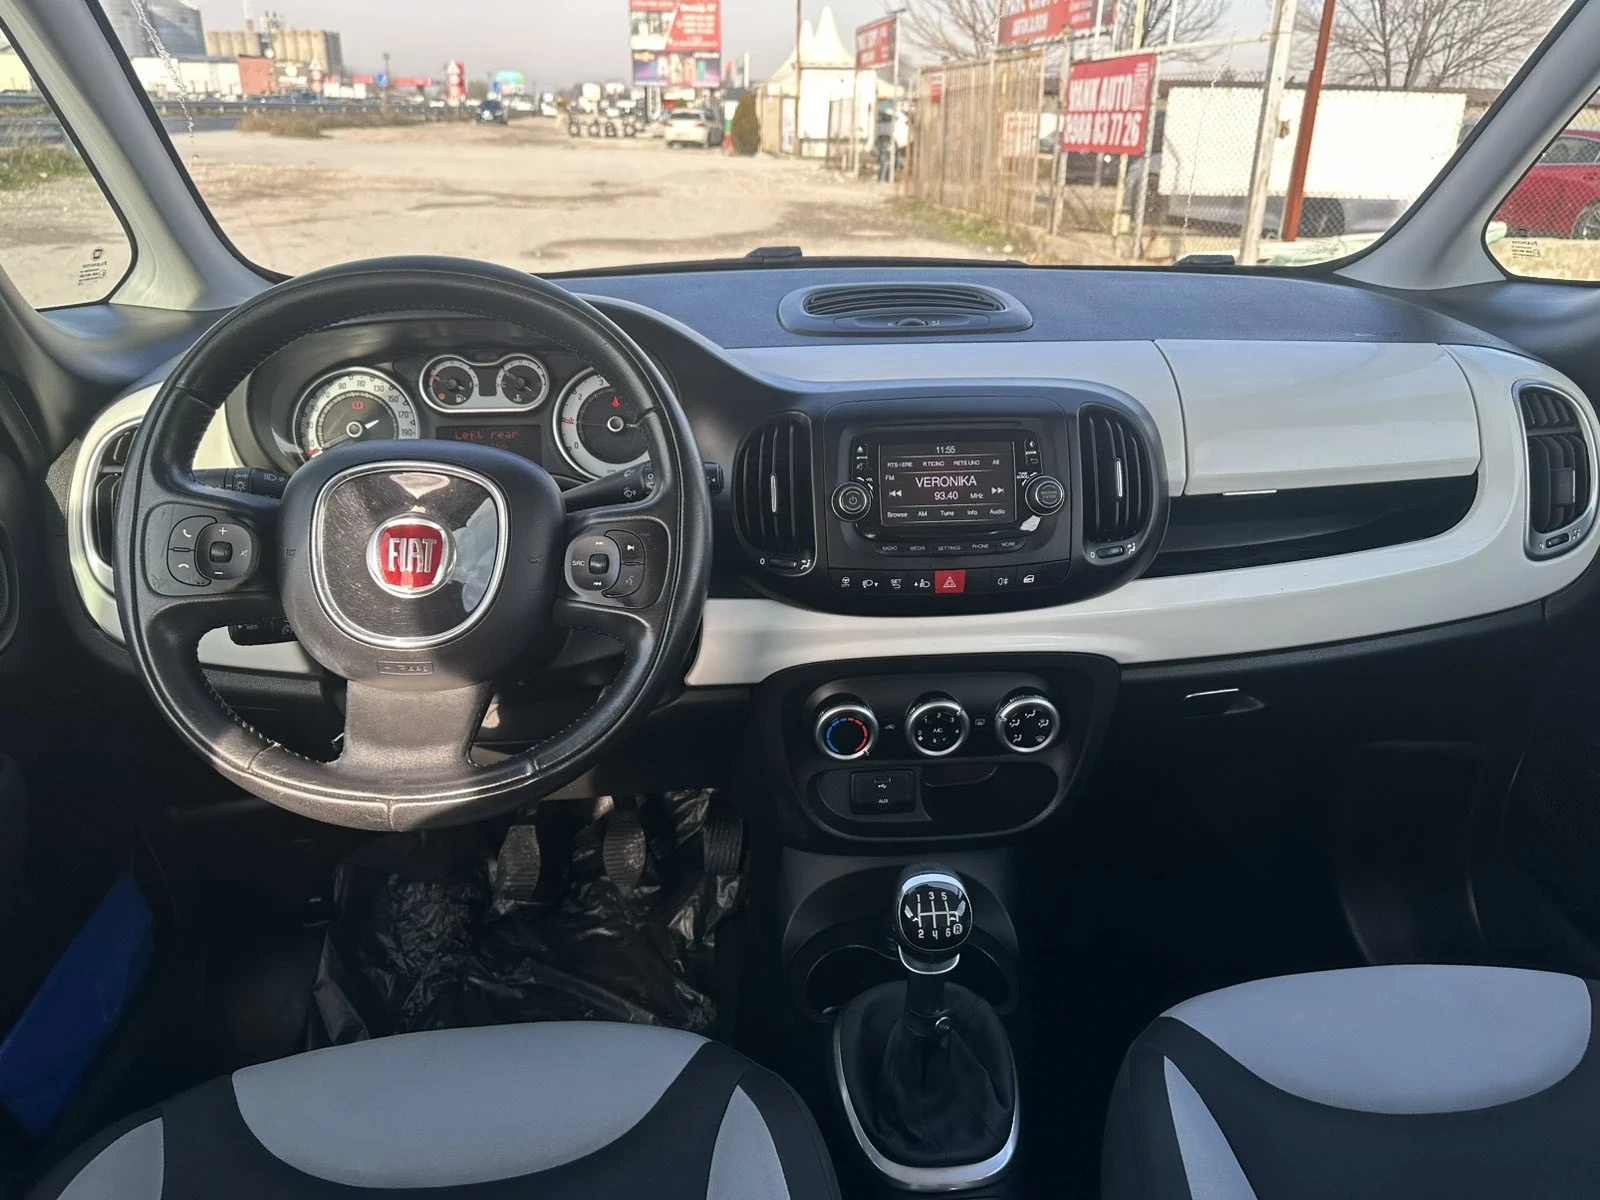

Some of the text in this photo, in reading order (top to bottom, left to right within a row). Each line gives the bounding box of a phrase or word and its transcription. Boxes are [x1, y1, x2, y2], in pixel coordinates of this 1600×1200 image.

[1098, 73, 1133, 111] AUTO
[1108, 113, 1124, 146] 77
[1122, 112, 1143, 147] 26
[373, 384, 385, 393] 130
[398, 411, 410, 419] 170
[401, 428, 414, 436] 190
[490, 431, 520, 440] rear
[936, 445, 956, 454] 11:55
[915, 475, 978, 488] VERONIKA
[934, 491, 959, 501] 93.40
[388, 537, 437, 574] FIAT
[928, 891, 935, 900] 3
[941, 891, 948, 900] 5
[917, 928, 925, 939] 2
[932, 930, 938, 940] 4
[945, 927, 952, 938] 6
